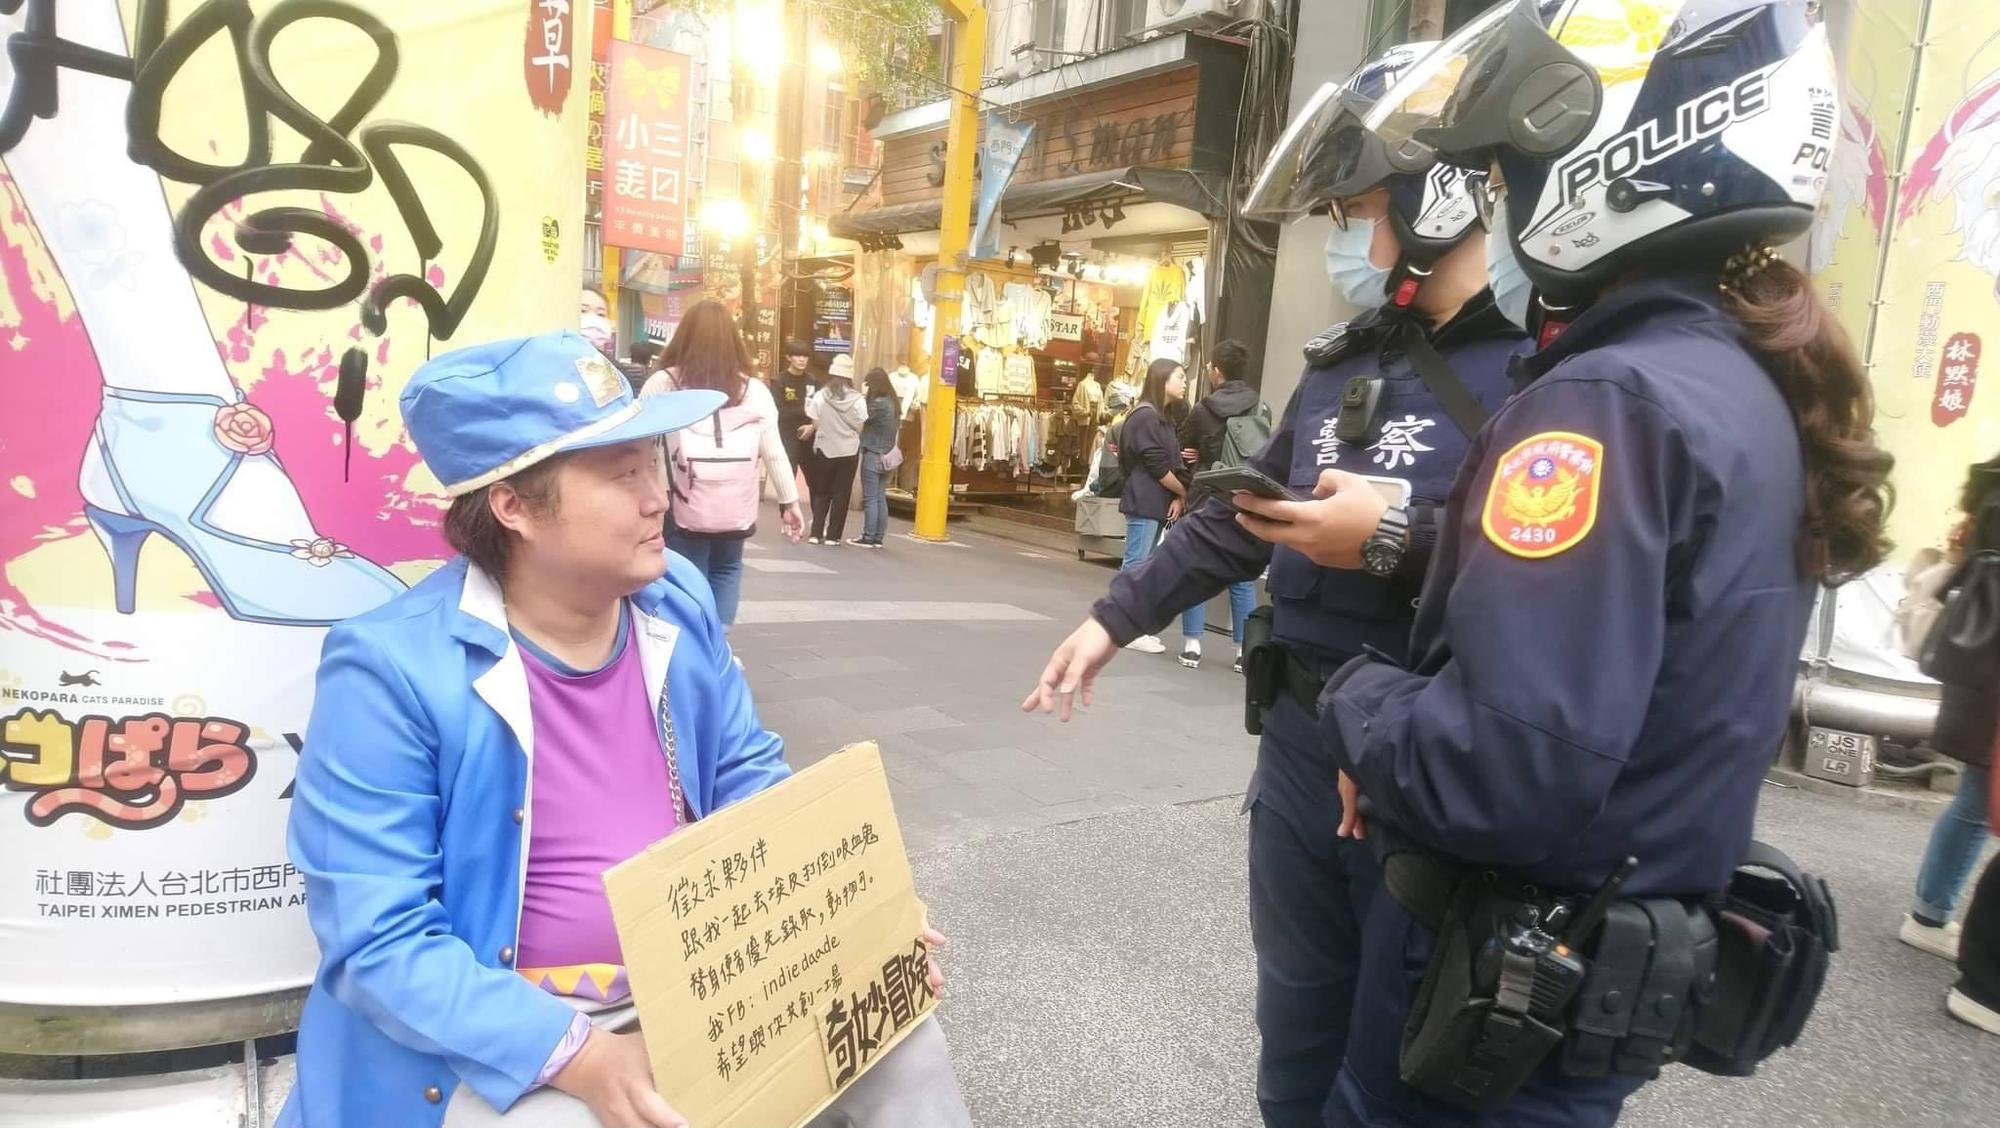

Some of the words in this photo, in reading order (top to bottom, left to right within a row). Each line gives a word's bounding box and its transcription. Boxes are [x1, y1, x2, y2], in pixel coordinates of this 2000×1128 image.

[1566, 73, 1765, 200] POLICE
[1510, 527, 1557, 543] 2430
[2, 688, 78, 703] NEKOPARA
[82, 696, 108, 704] CATS
[112, 697, 164, 706] PARADISE
[0, 710, 256, 796] コぱら
[38, 903, 96, 918] TAIPEI
[101, 904, 159, 918] XIMEN
[166, 896, 282, 917] PEDESTRIAN
